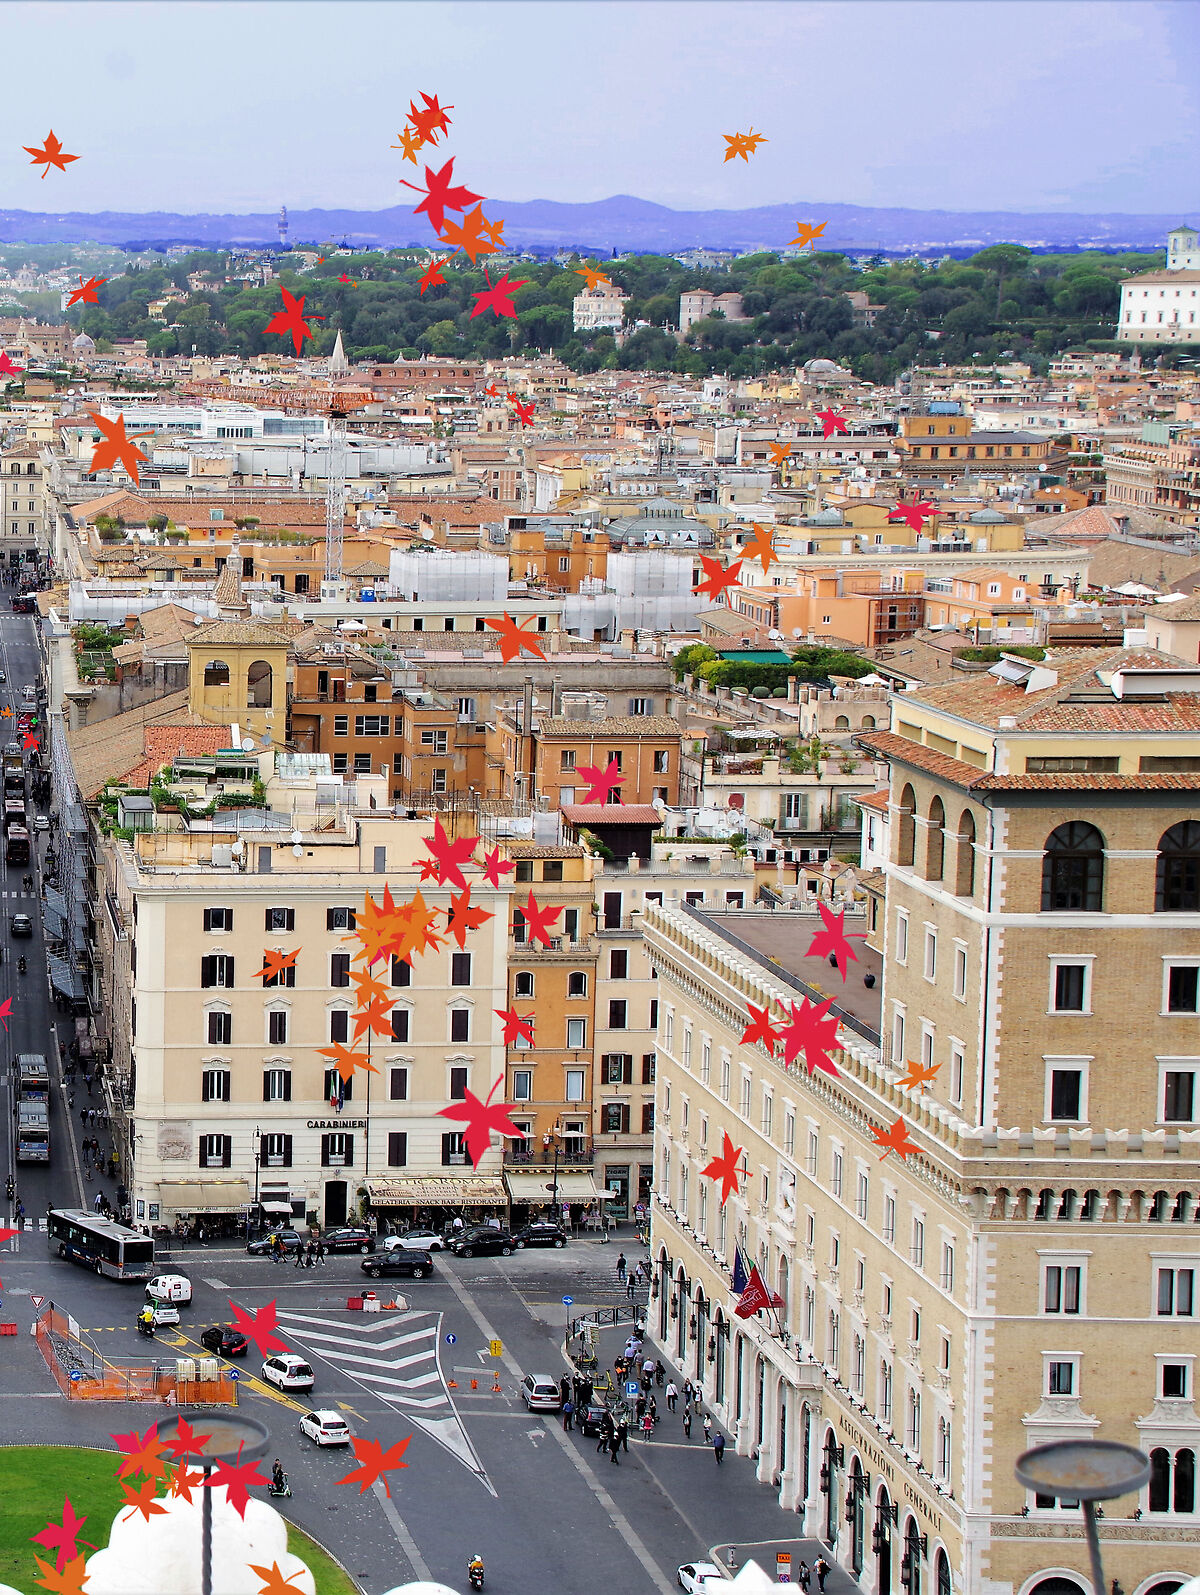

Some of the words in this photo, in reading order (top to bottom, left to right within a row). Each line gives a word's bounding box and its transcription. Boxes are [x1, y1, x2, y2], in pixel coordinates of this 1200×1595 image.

[306, 1120, 367, 1129] CARABINIERI
[628, 1383, 637, 1393] P
[903, 1482, 941, 1532] GENERALI
